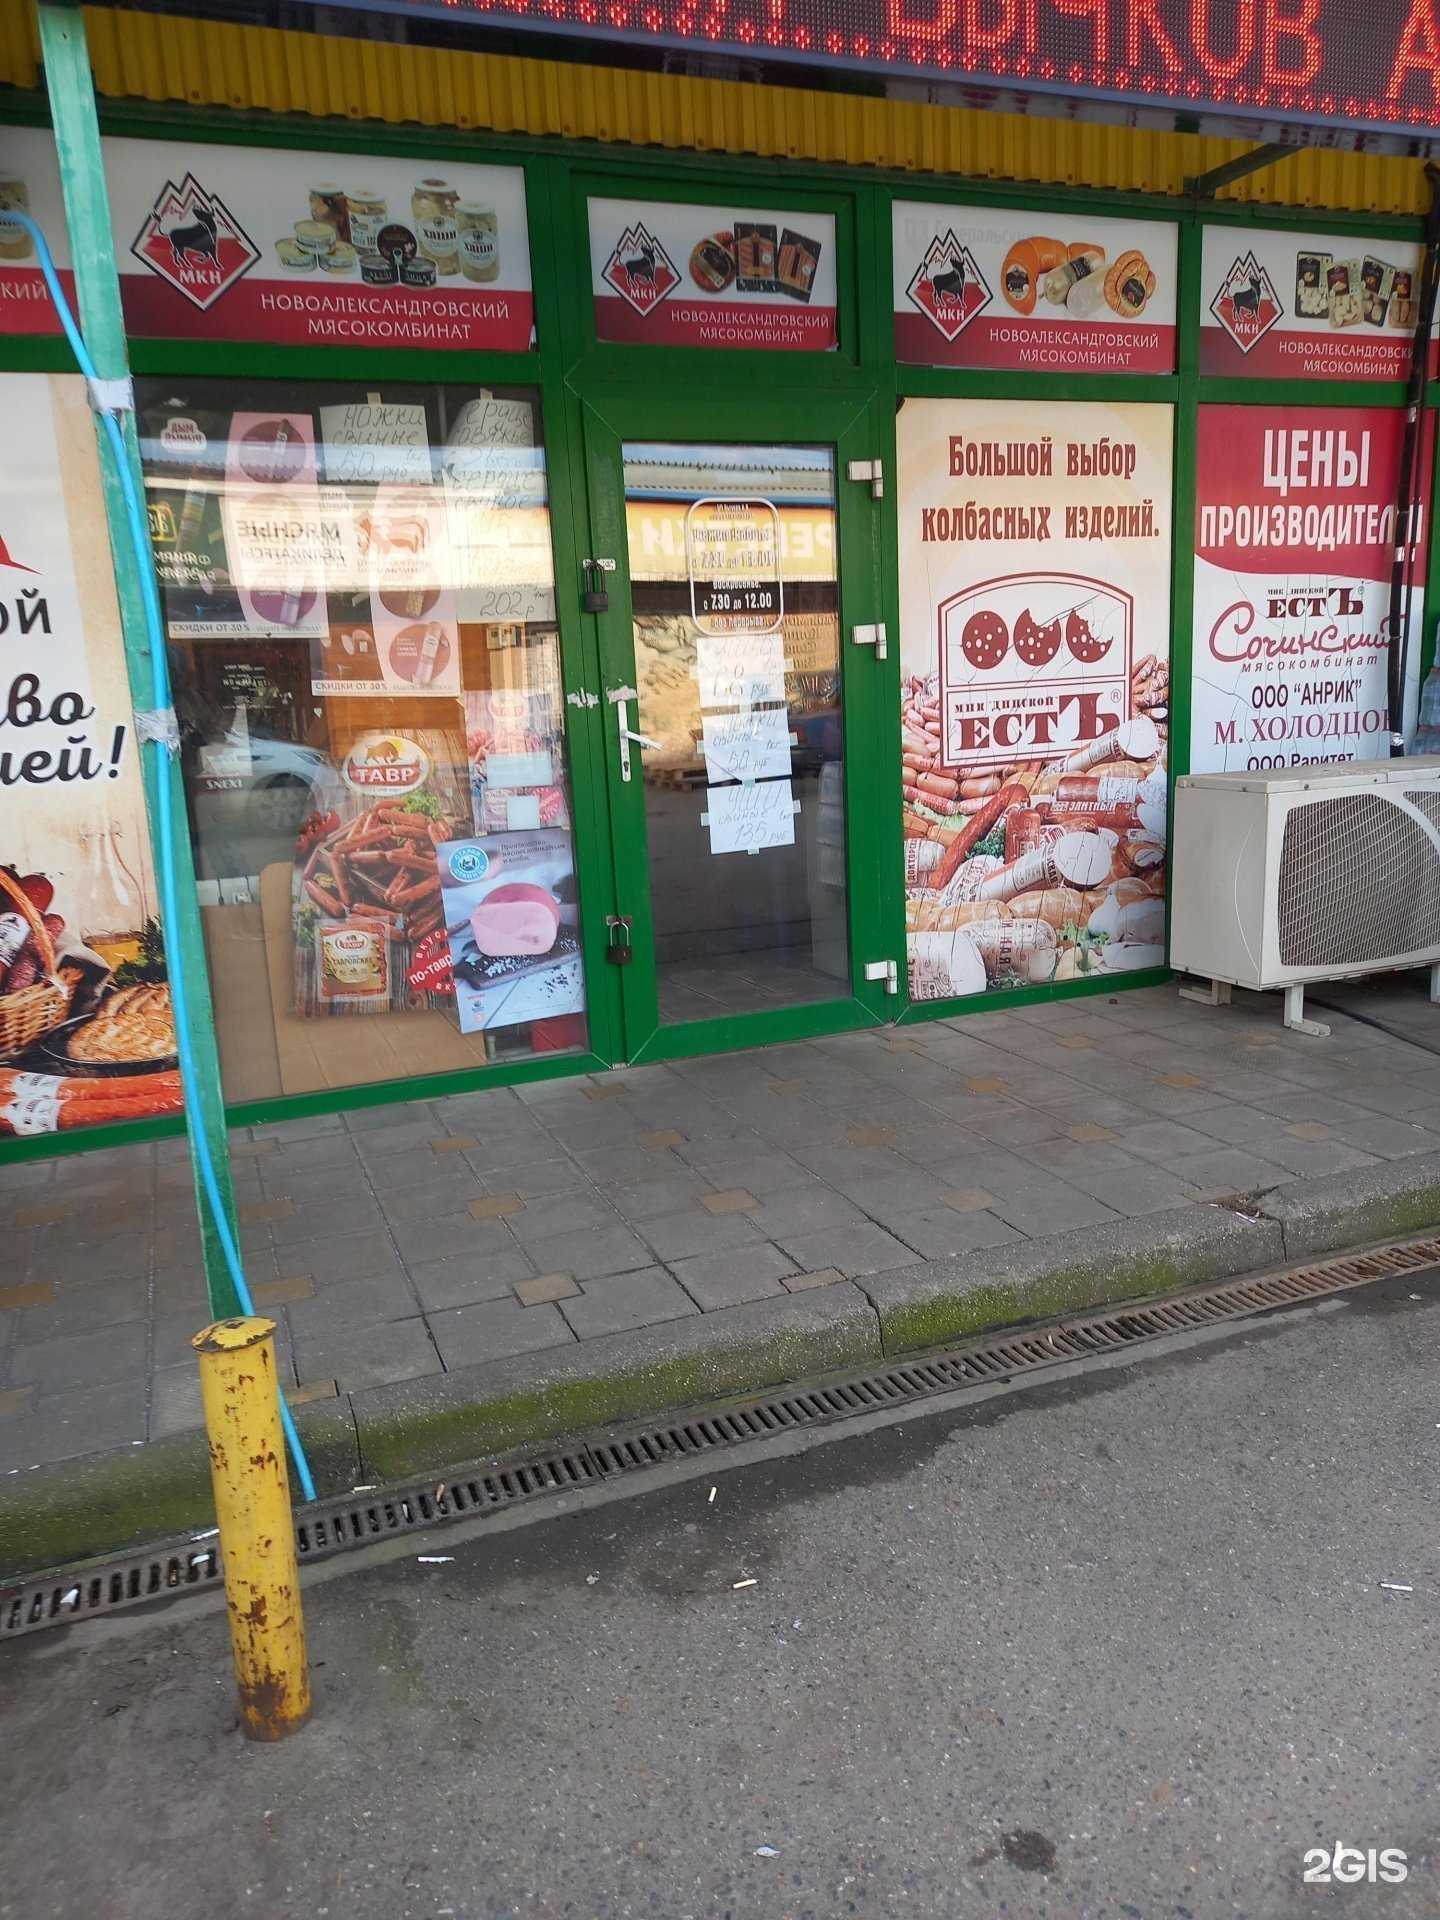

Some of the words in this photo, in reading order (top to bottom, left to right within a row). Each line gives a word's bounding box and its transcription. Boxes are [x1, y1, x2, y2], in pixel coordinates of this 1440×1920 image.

[179, 268, 222, 286] МКН
[630, 288, 657, 300] МКН
[261, 293, 510, 319] НОВОАЛЕКСАНДРОВСКИЙ
[935, 308, 965, 321] МКН
[671, 309, 830, 328] НОВОАЛЕКСАНДРОВСКИЙ
[308, 319, 471, 340] МЯСОКОМБИНАТ
[699, 326, 805, 343] МЯСОКОМБИНАТ
[989, 328, 1159, 348] НОВОАЛЕКСАНДРОВСКИЙ
[1233, 322, 1259, 335] МКН
[1019, 349, 1132, 365] МЯСОКОМБИНАТ
[1303, 359, 1401, 376] МЯСОКОМБИНАТ
[949, 435, 1053, 477] Большой
[1066, 437, 1137, 480] выбор
[1263, 429, 1371, 497] ЦЕНЫ
[921, 501, 1052, 542] колбасных
[1064, 498, 1160, 541] изделий.
[1200, 496, 1424, 552] ПРОИЗВОДИТЕЛЙ
[479, 590, 523, 617] 202
[733, 599, 742, 610] до
[745, 592, 772, 609] 12.00
[1241, 655, 1378, 673] мясокомбинат
[0, 673, 95, 727] во
[1251, 684, 1288, 709] ООО
[1214, 719, 1243, 745] М.
[355, 767, 414, 783] ТАВР
